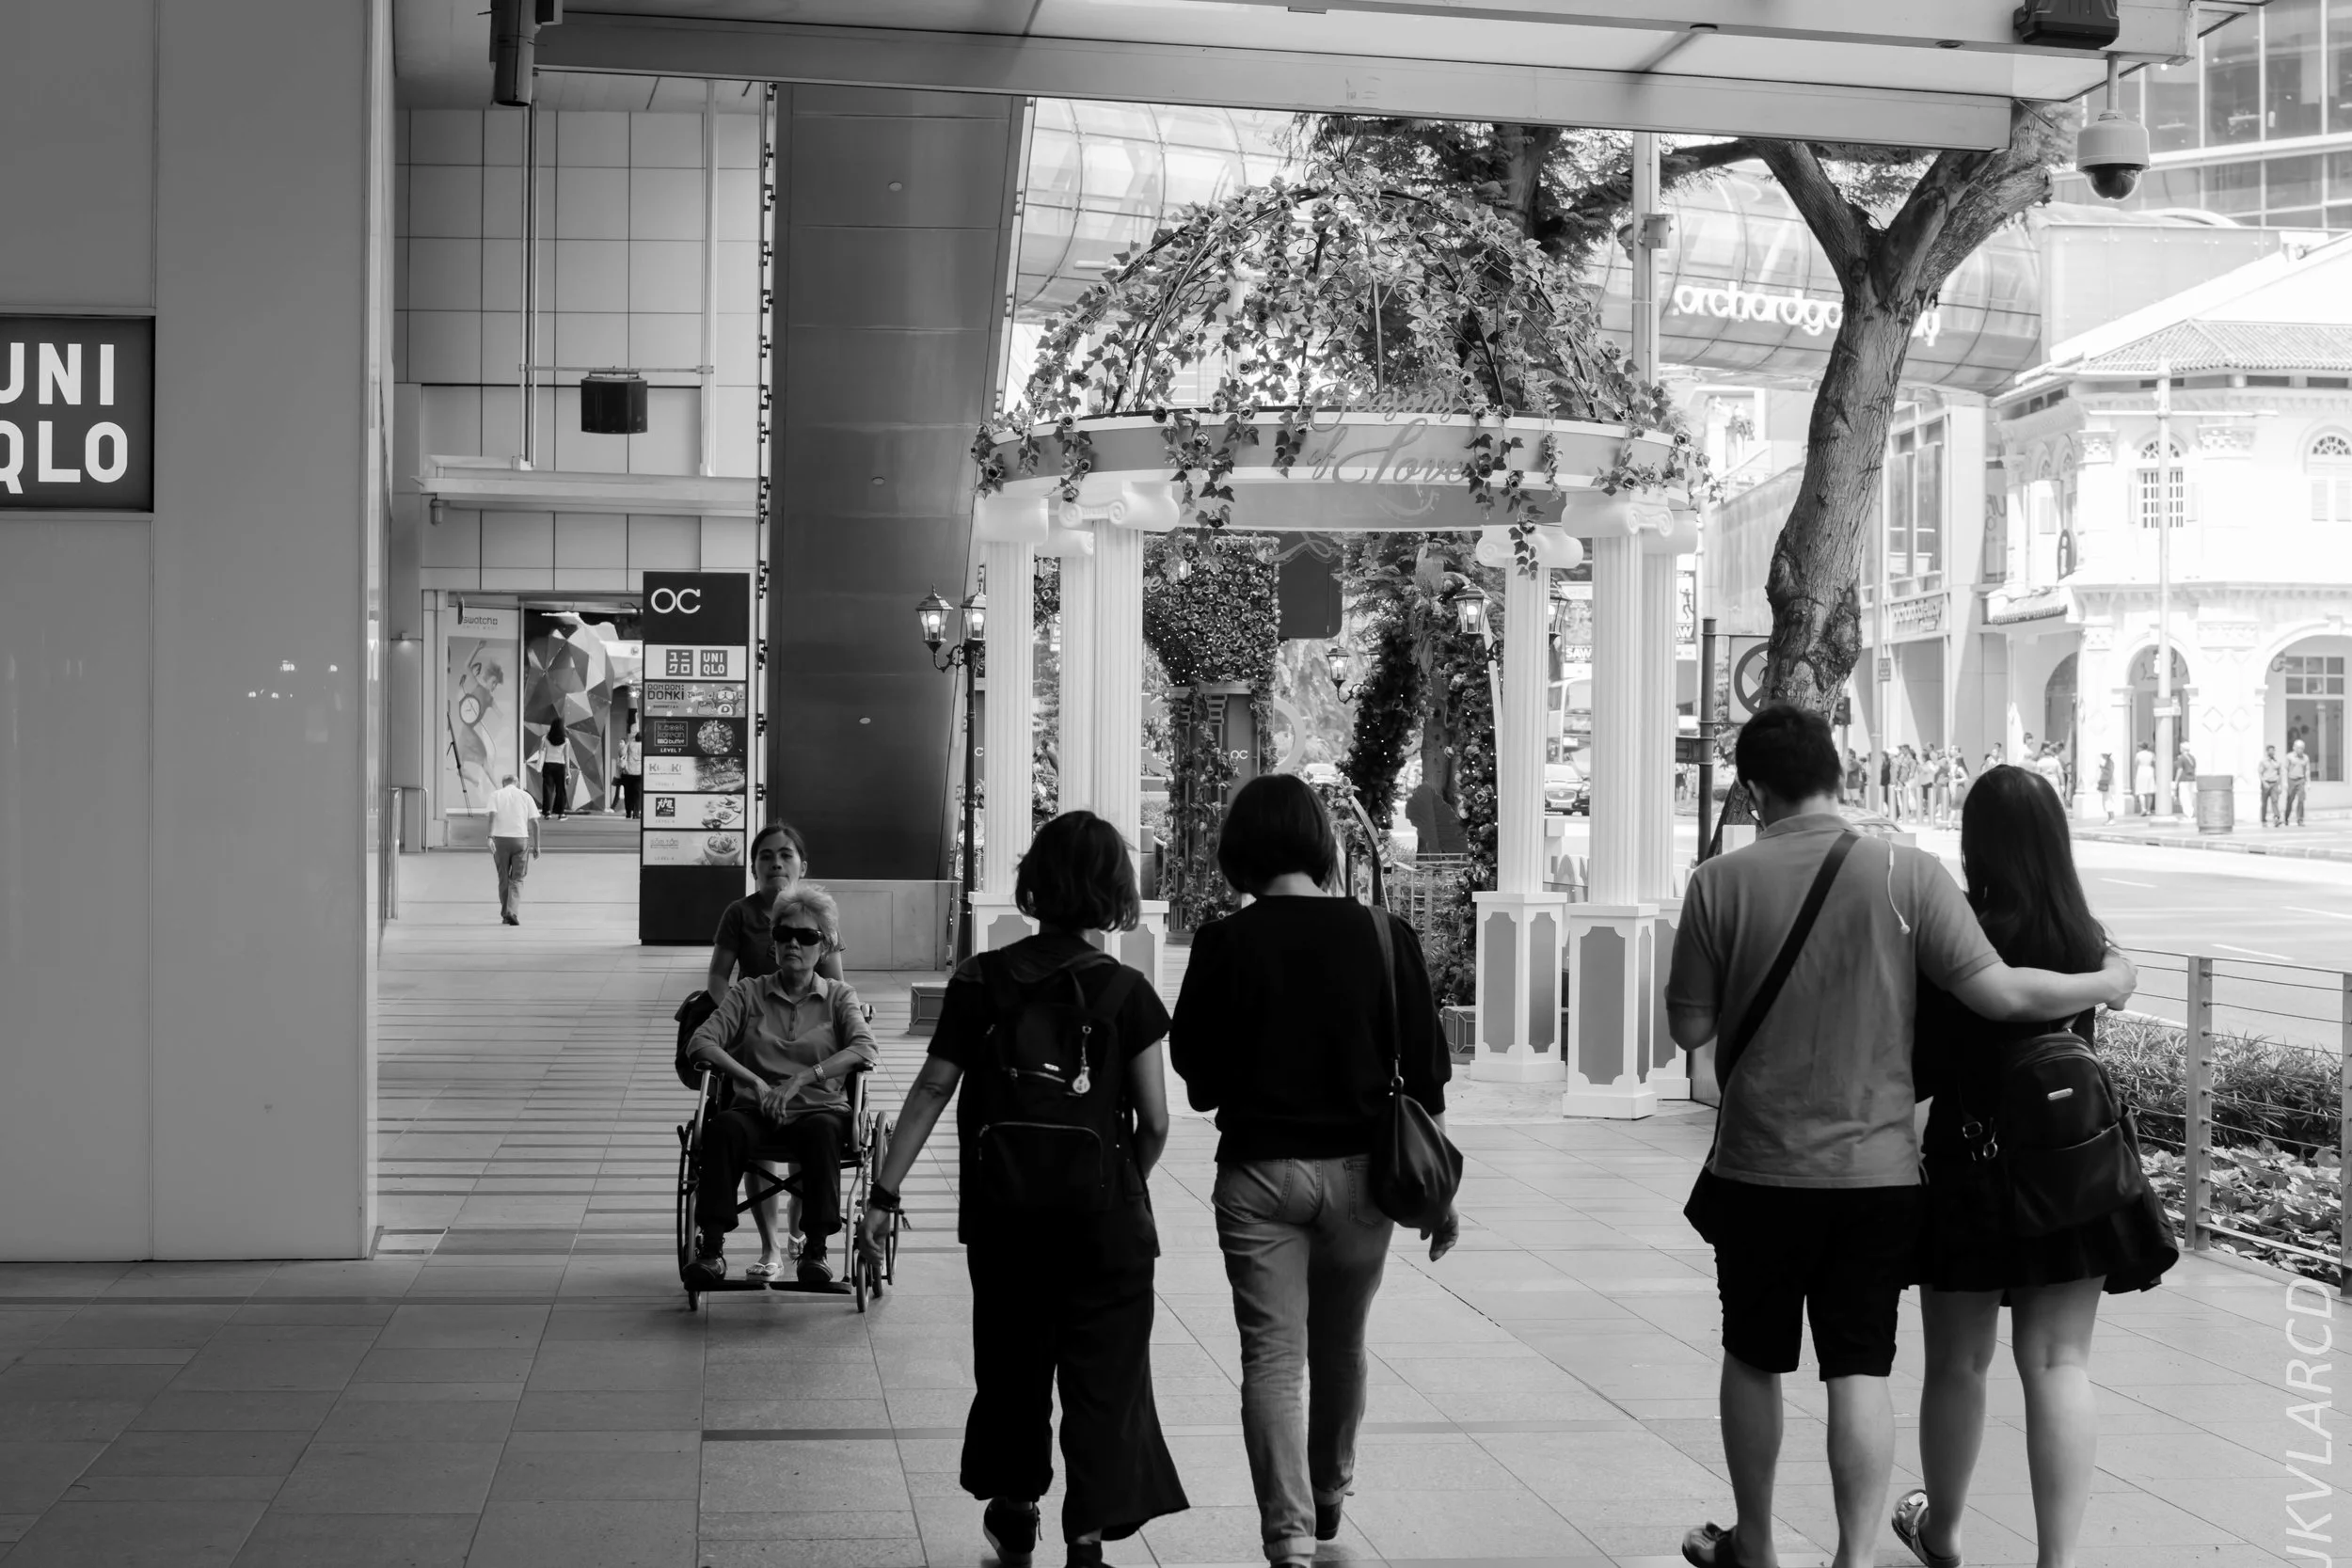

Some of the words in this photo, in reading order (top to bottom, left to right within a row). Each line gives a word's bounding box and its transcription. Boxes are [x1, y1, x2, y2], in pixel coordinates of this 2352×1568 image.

[1307, 425, 1349, 480] of
[1331, 417, 1469, 485] Love
[650, 588, 701, 613] OC
[463, 616, 493, 625] swatch
[703, 653, 723, 663] UNI
[703, 664, 725, 675] QLO
[1230, 750, 1248, 760] OC
